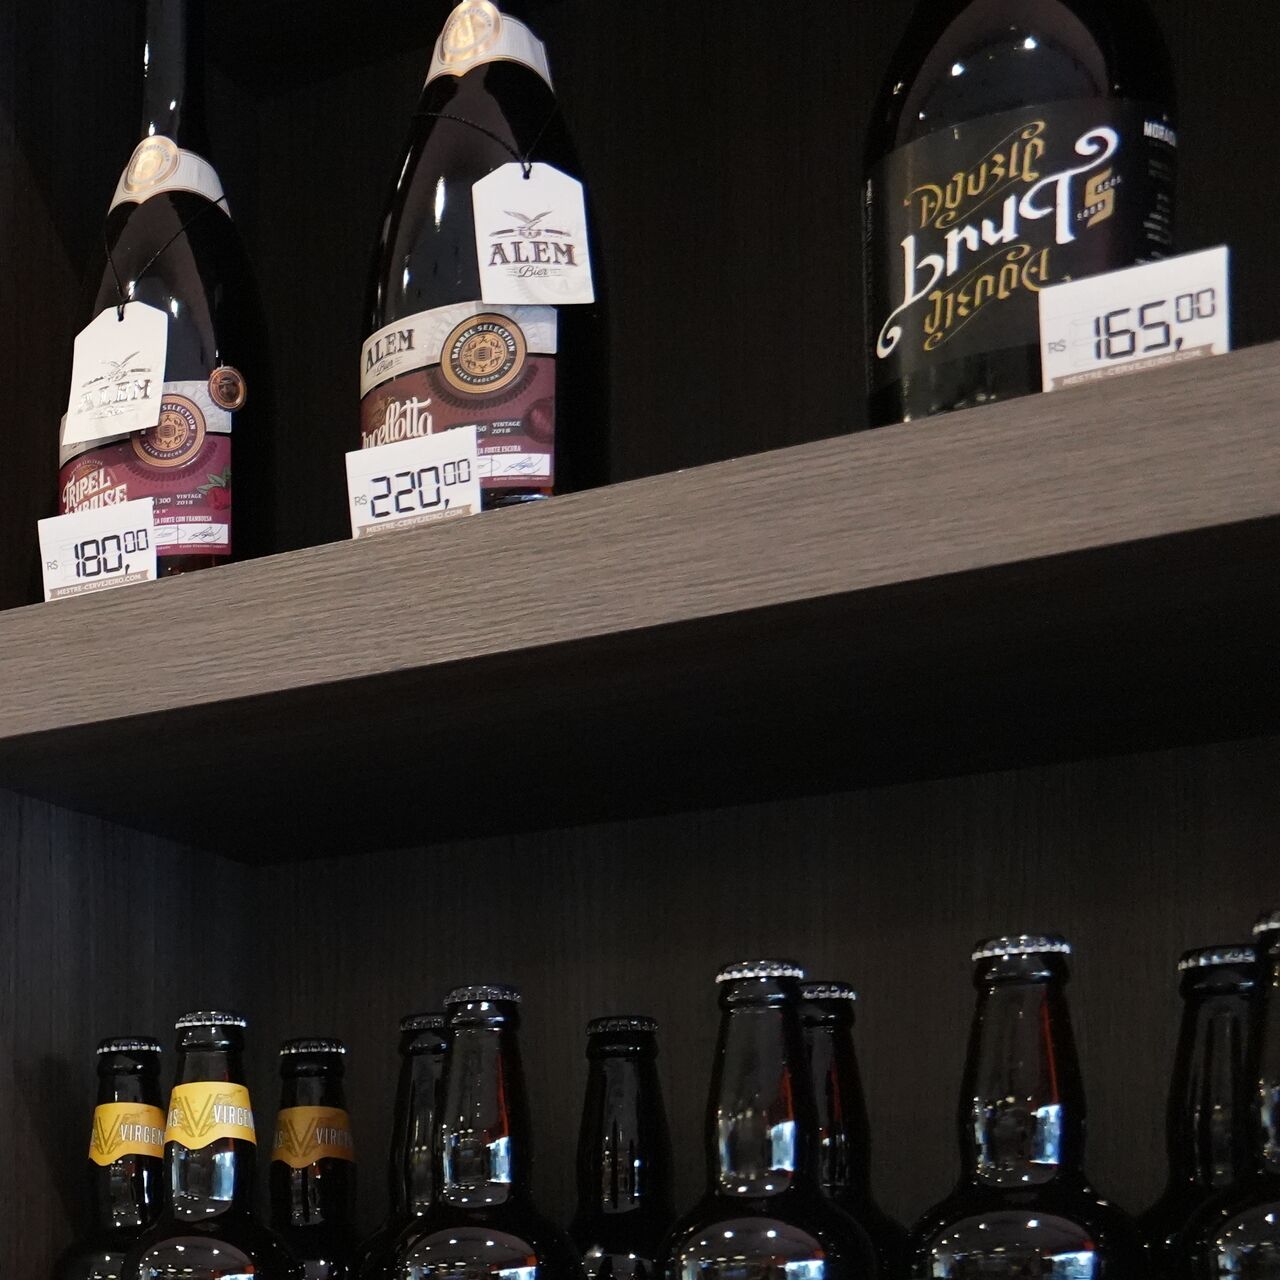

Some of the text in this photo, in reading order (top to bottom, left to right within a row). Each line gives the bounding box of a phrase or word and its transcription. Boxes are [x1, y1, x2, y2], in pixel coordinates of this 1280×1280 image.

[488, 240, 579, 268] ALEM
[517, 264, 549, 278] Bier
[451, 322, 517, 359] BARREL SELECTION
[1094, 286, 1217, 361] 165,00
[364, 328, 416, 374] ALEM
[492, 420, 521, 428] VINTAGE
[62, 467, 112, 503] TRIPEL
[369, 457, 472, 519] 220,00
[365, 507, 464, 535] MESTRE-CERVEJEIRO.COM
[73, 527, 149, 578] 180,00
[56, 573, 143, 596] MESTRE-CERVEJEIRO.COM
